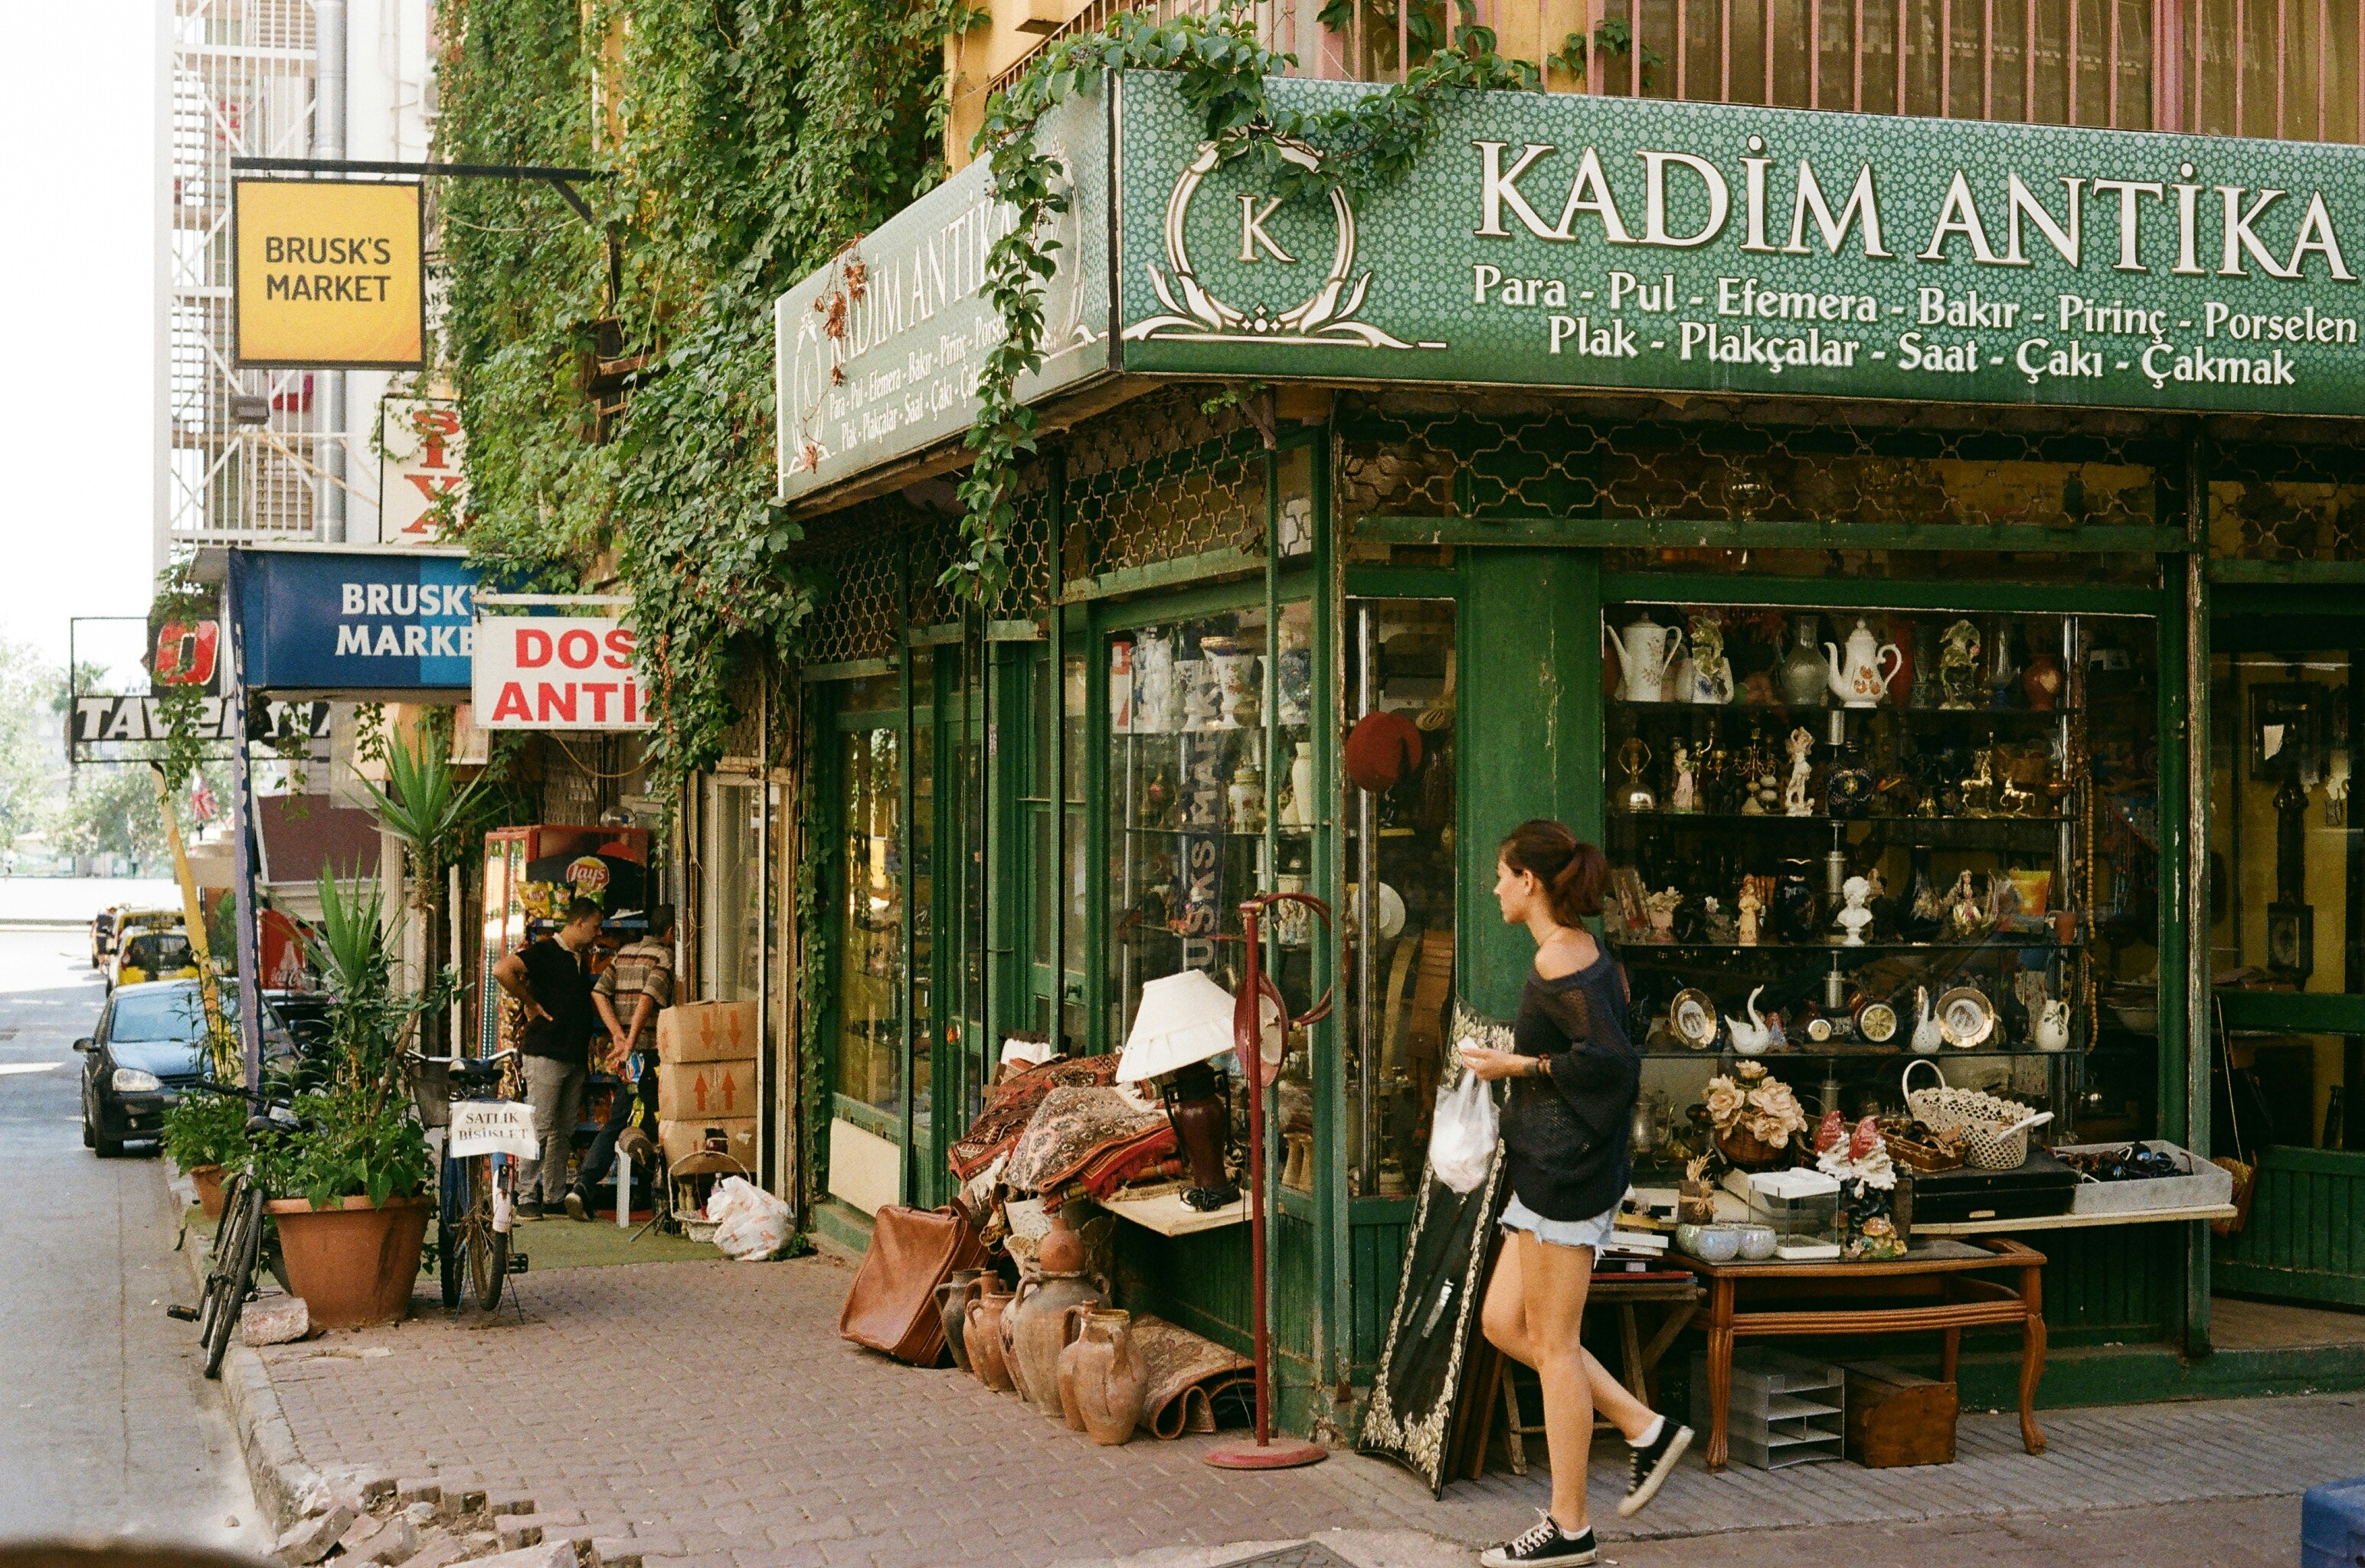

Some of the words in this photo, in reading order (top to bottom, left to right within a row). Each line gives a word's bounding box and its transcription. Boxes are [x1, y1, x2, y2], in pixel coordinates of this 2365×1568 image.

[1237, 195, 1297, 263] K
[1471, 135, 1893, 257] KADİM
[1917, 162, 2357, 280] ANTİKA
[266, 236, 391, 265] BRUSK'S
[267, 274, 391, 302] MARKET
[1472, 264, 1567, 306] Para
[1608, 271, 1676, 312] Pul
[1717, 276, 1878, 322] Efemera
[1918, 287, 2020, 328] Bakır
[2058, 294, 2167, 345] Pirinç
[2203, 301, 2357, 343] Porselen
[829, 393, 846, 422] Para
[851, 377, 864, 411] Pul
[869, 369, 901, 402] Efemera
[908, 348, 933, 384] Bakır
[940, 332, 967, 369] Pirinç
[976, 302, 1009, 351] Porsel
[1547, 315, 1638, 358] Plak
[1678, 321, 1860, 374] Plakçalar
[1898, 332, 1978, 373] Saat
[2016, 338, 2103, 384] Çakı
[2141, 343, 2296, 390] Çakmak
[842, 418, 858, 452] Plak
[862, 402, 898, 444] Plakçalar
[904, 391, 924, 426] Saat
[931, 376, 953, 421] Çakı
[960, 361, 989, 408] Çak
[335, 624, 473, 657] MARKE
[515, 629, 637, 670] DOS
[466, 1112, 518, 1125] SATLIK
